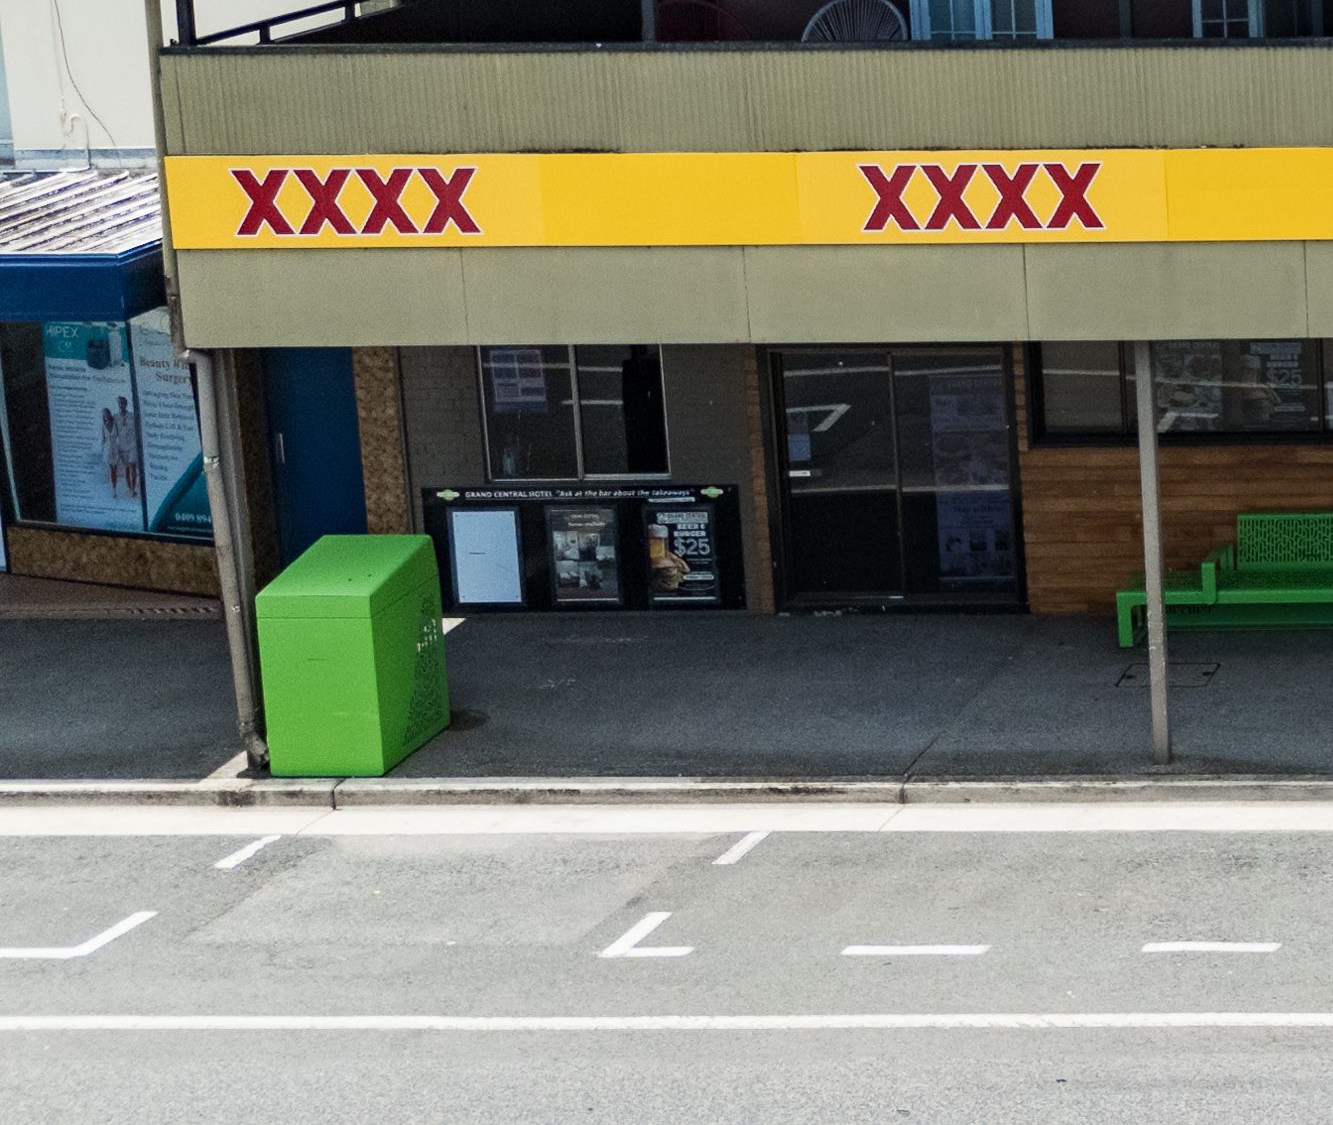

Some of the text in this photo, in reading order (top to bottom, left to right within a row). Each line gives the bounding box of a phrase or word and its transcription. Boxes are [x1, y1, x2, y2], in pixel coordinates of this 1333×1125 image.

[231, 167, 483, 235] XXXX
[858, 162, 1106, 231] XXXX
[1266, 368, 1301, 388] $25
[673, 537, 711, 557] $25
